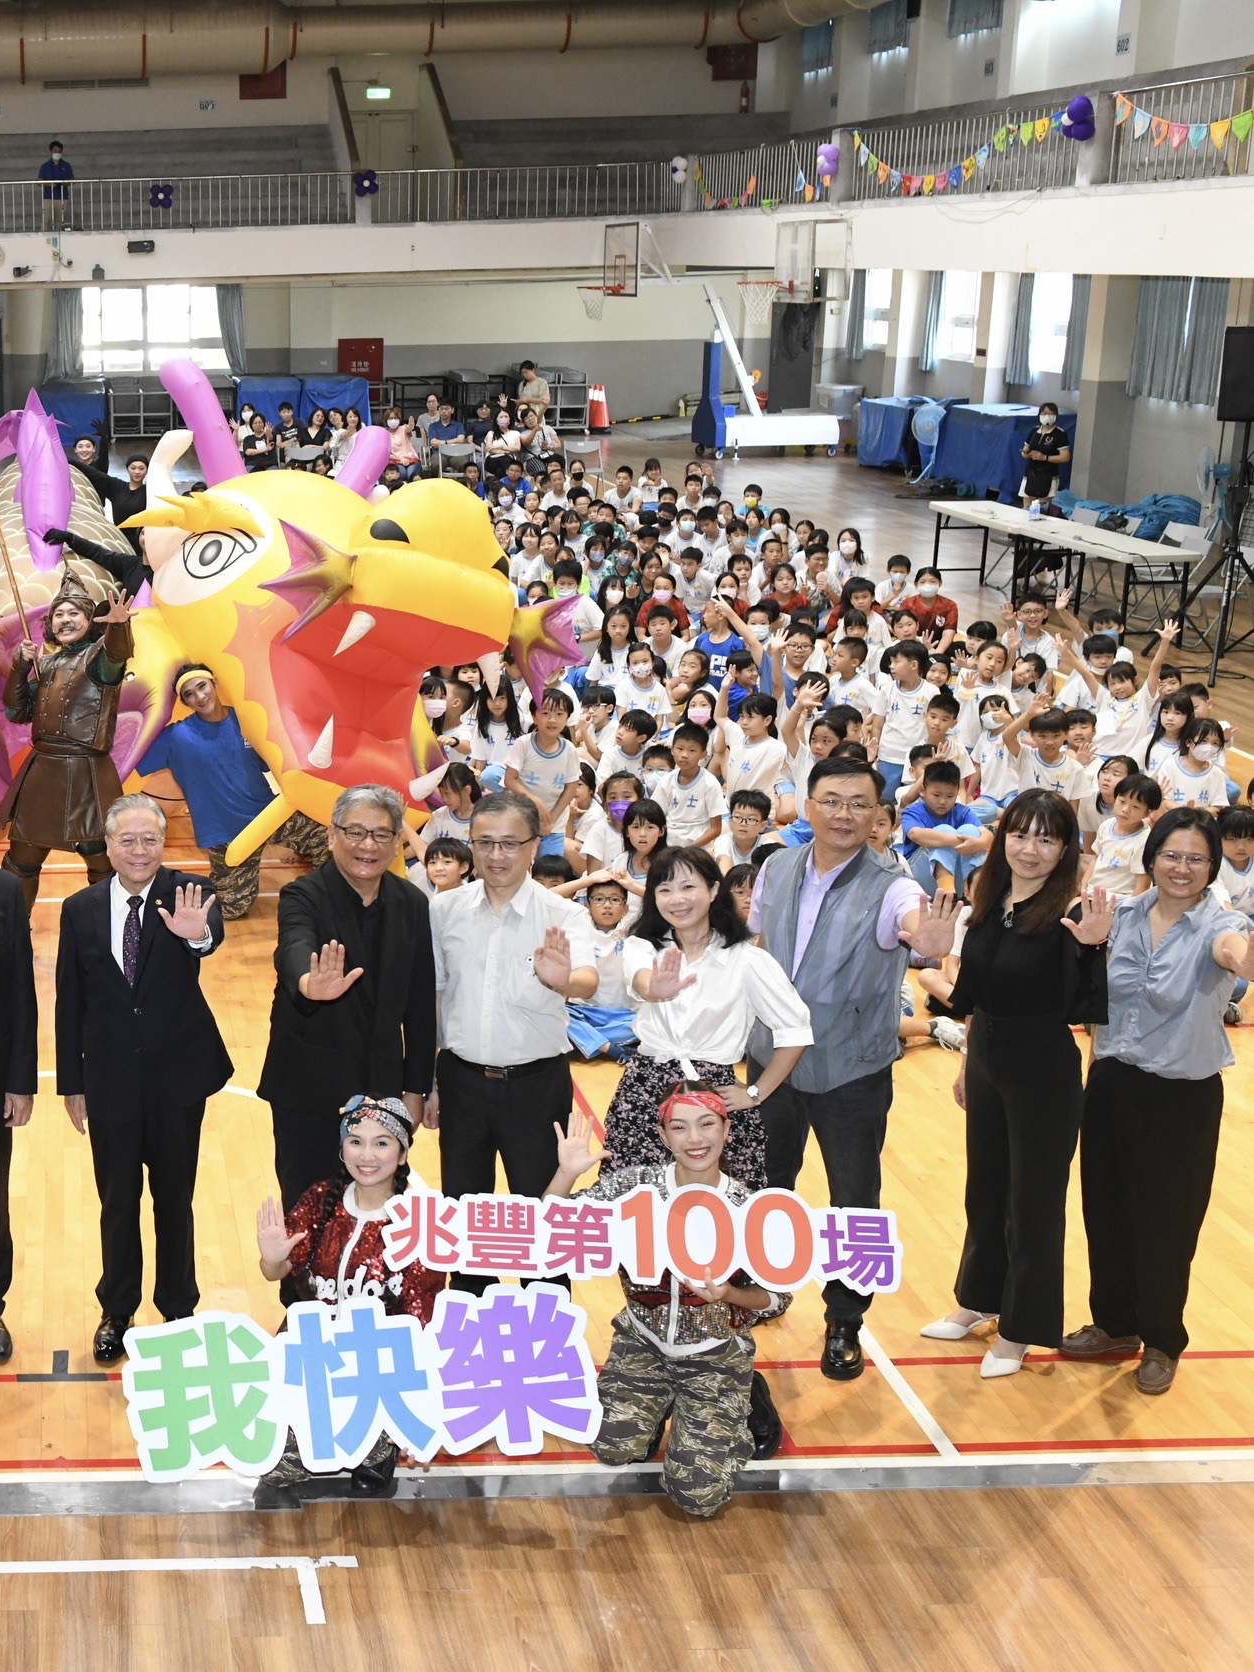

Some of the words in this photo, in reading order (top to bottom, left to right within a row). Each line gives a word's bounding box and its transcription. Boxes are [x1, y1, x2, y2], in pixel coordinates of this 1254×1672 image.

[1116, 37, 1130, 53] 602
[199, 100, 215, 110] 605
[524, 771, 565, 789] 士林
[1174, 788, 1209, 803] 士林
[389, 1189, 895, 1289] 兆豐第100場
[133, 1292, 592, 1472] 我快樂
